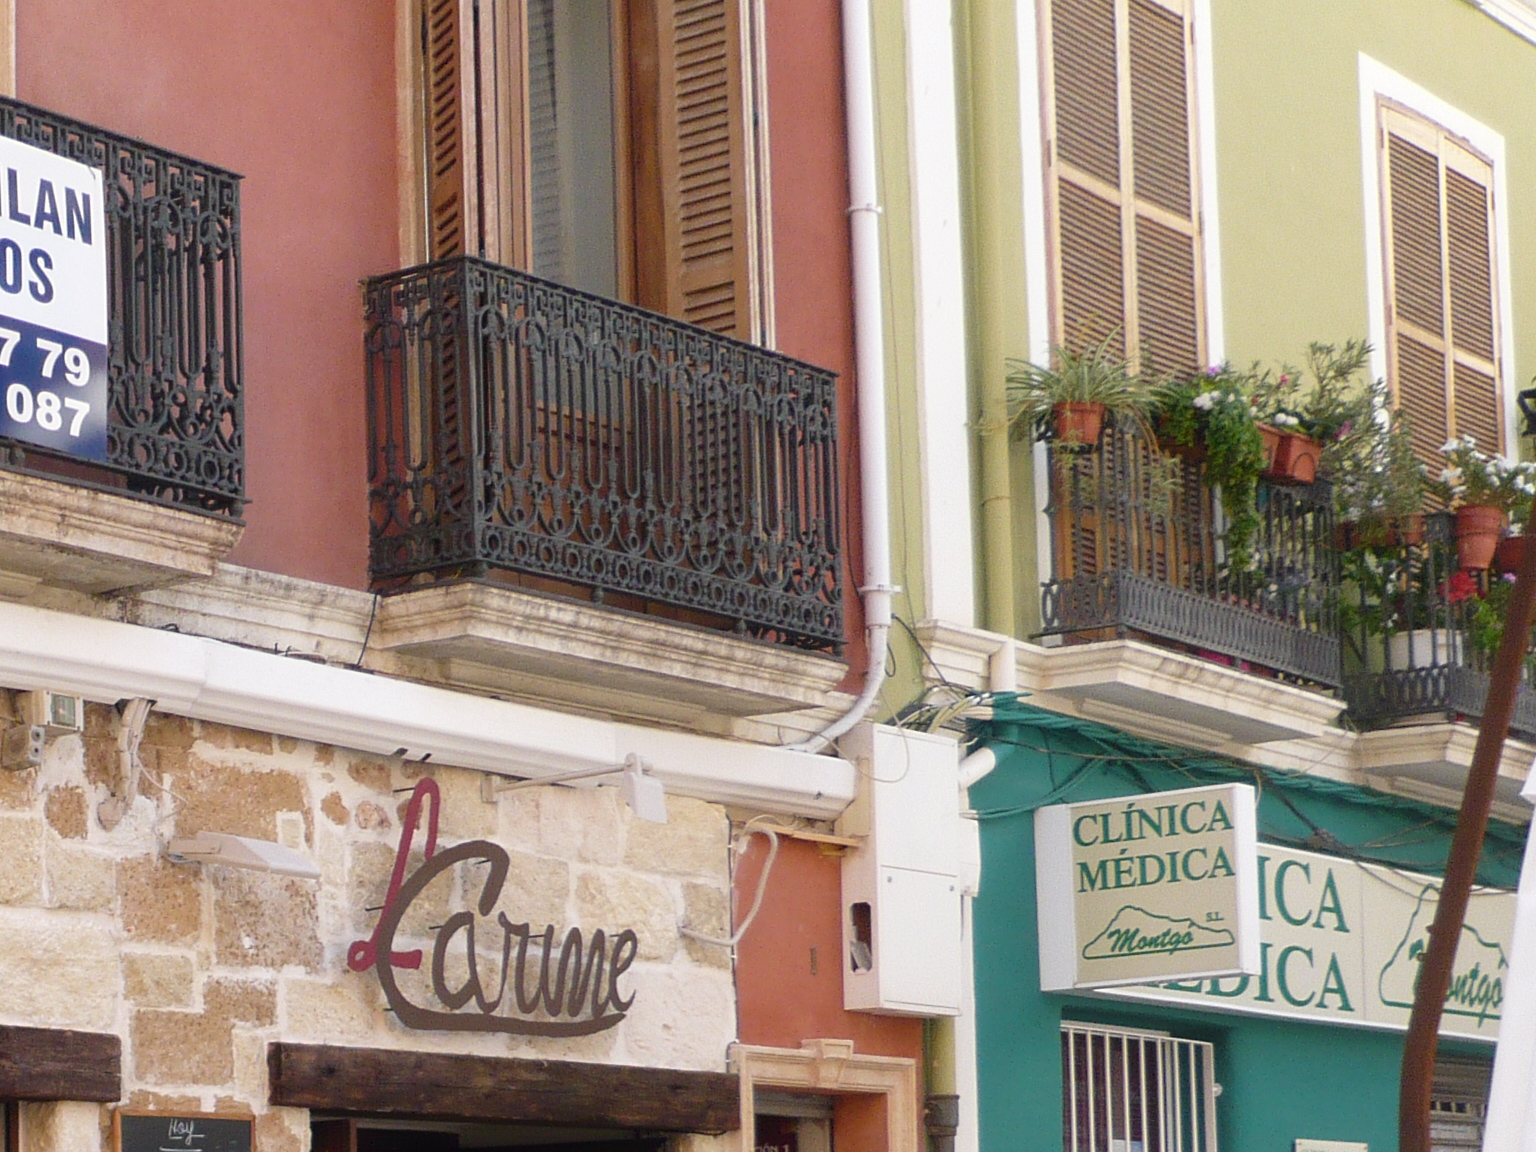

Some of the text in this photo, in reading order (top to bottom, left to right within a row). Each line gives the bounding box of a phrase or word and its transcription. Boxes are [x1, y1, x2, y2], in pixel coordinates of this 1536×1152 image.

[36, 338, 91, 387] 79
[6, 383, 91, 438] 087
[1073, 799, 1234, 847] CLÍNICA
[1076, 846, 1236, 893] MÉDICA
[1107, 922, 1195, 956] Montgó
[169, 1118, 205, 1145] Hoy
